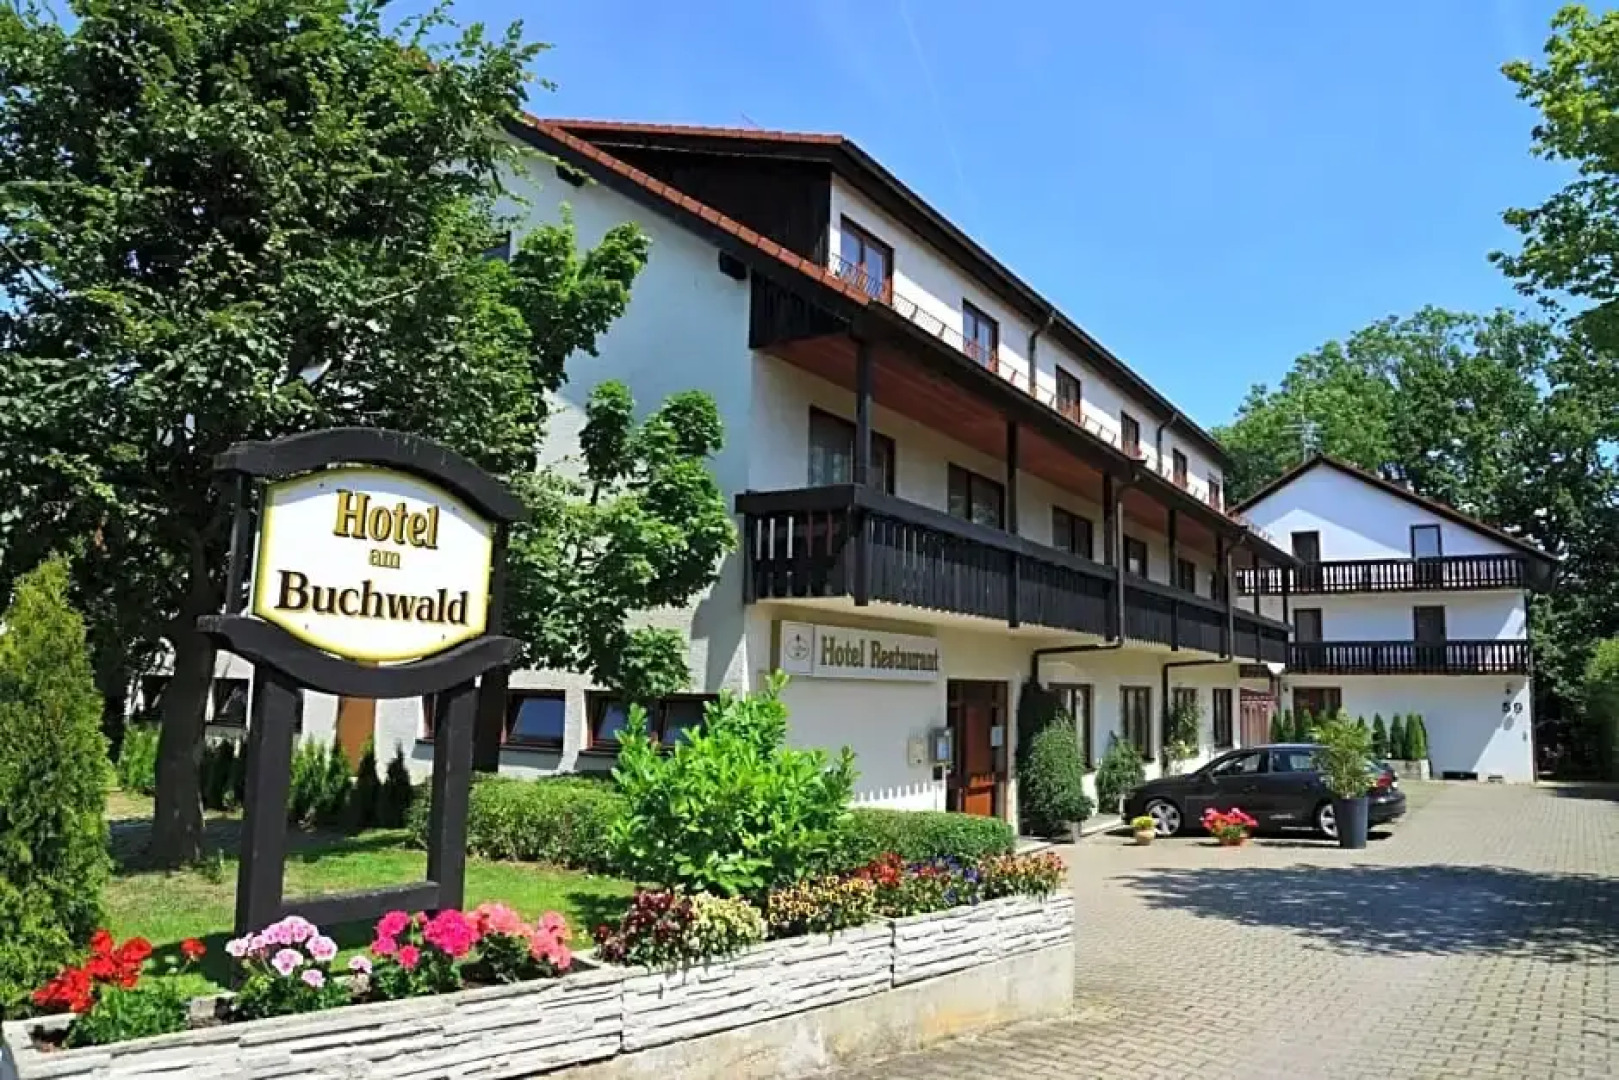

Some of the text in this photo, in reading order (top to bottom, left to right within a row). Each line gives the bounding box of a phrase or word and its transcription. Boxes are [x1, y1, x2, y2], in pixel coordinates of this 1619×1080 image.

[334, 489, 439, 550] Hotel
[369, 549, 400, 569] am
[274, 570, 469, 626] Buchwald
[820, 635, 939, 671] Hotel Restaurant
